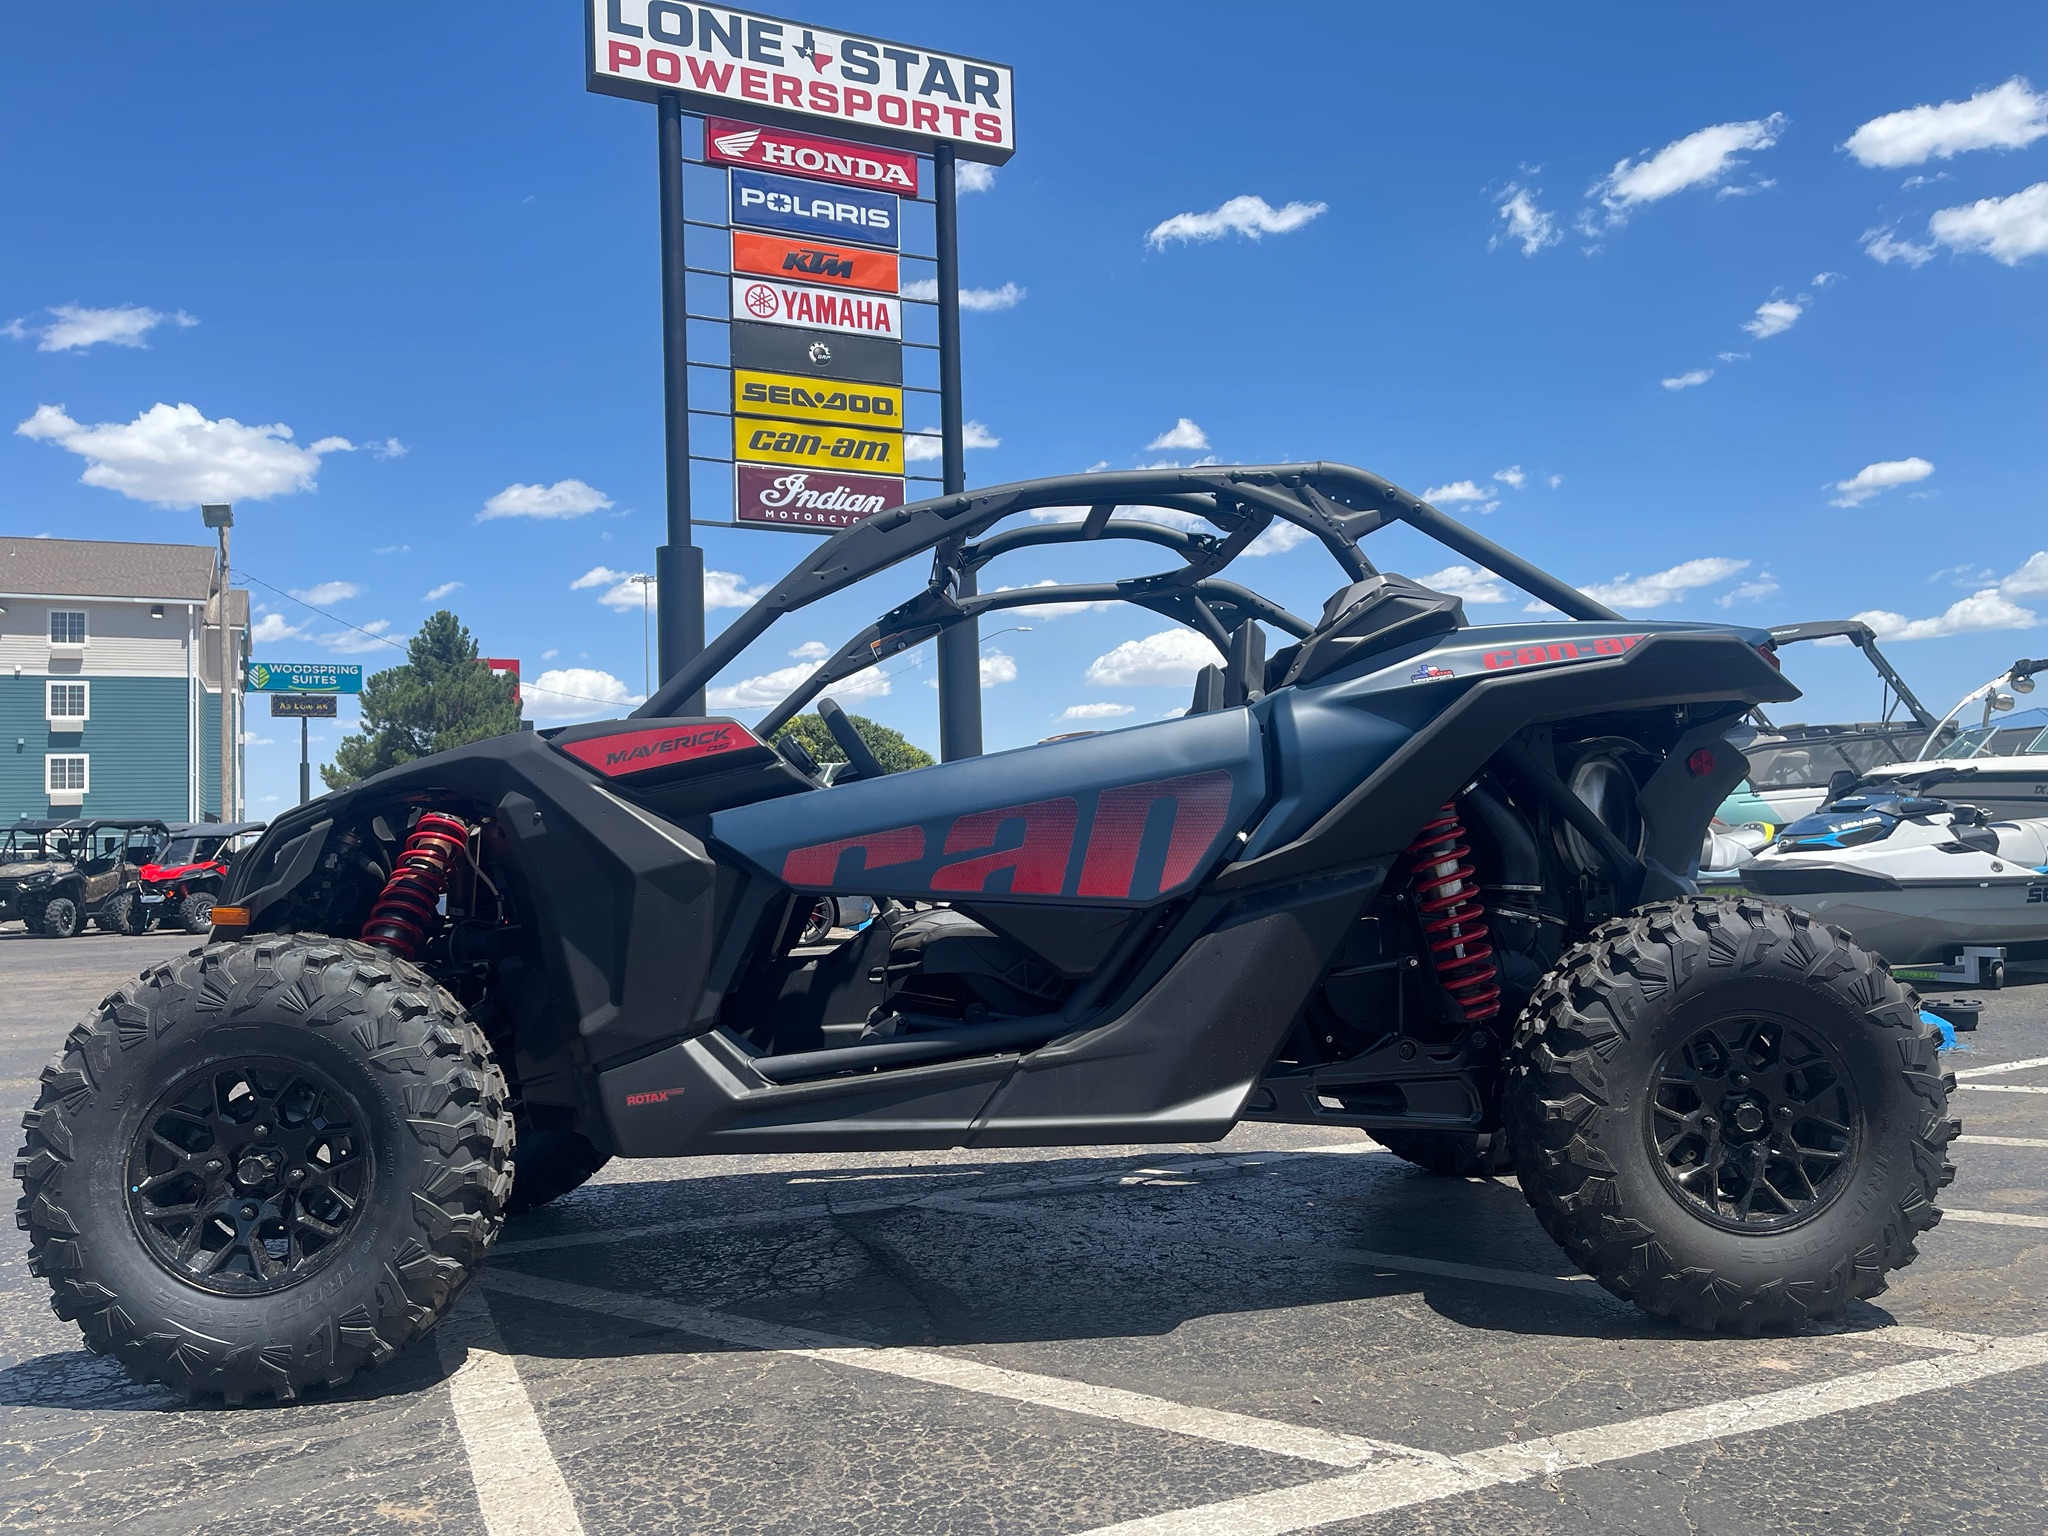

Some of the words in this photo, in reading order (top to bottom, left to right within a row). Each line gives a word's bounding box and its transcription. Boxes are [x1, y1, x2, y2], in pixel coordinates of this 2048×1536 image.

[607, 0, 785, 68] LONE
[840, 39, 1001, 109] STAR
[608, 40, 1003, 144] POWERSPORTS
[762, 142, 914, 187] HONDA
[741, 187, 890, 229] POLARIS
[782, 249, 854, 279] KTM
[781, 289, 892, 333] YAMAHA
[748, 429, 891, 463] can-am
[759, 473, 886, 514] Indian
[269, 664, 359, 675] WOODSPRING
[292, 675, 337, 685] SUITES
[606, 727, 730, 766] MAVERICK
[627, 1091, 667, 1105] ROTAX
